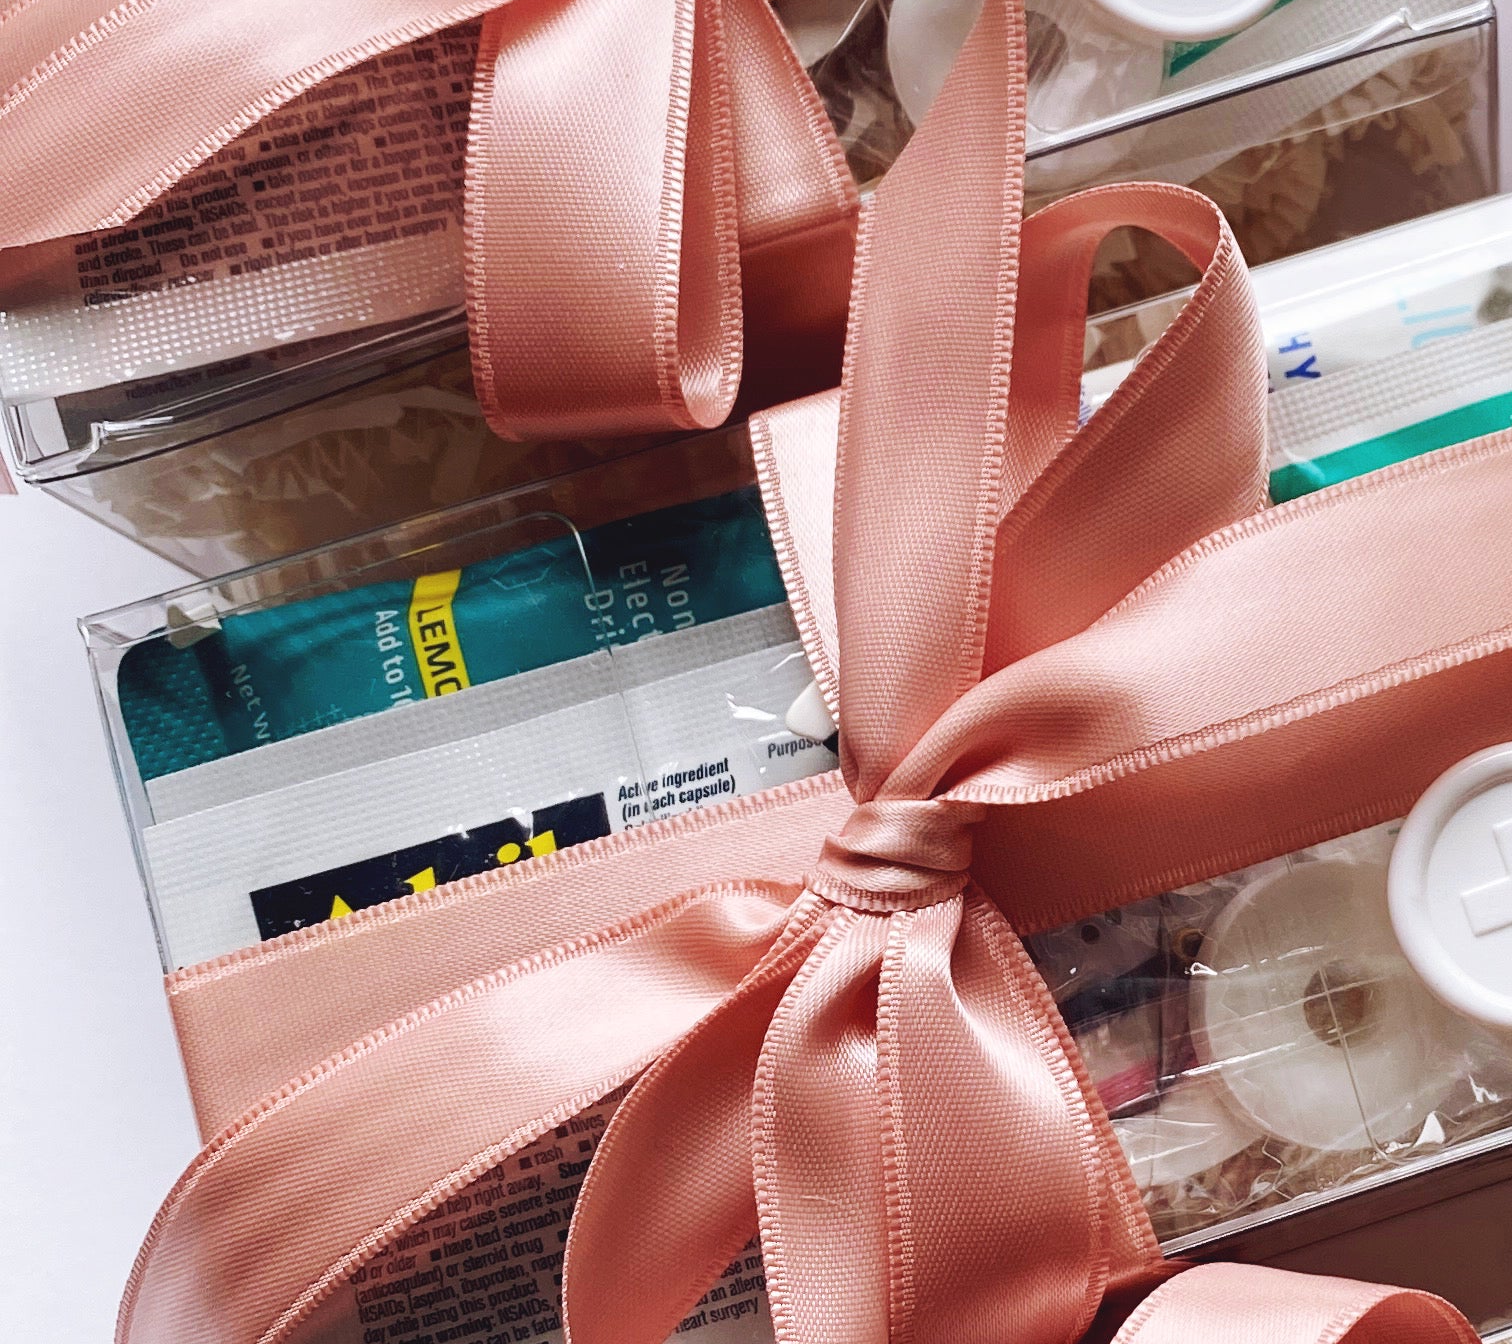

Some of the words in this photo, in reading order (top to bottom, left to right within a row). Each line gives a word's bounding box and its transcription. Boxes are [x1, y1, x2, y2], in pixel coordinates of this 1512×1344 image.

[191, 185, 239, 213] product
[150, 235, 184, 254] These
[620, 560, 663, 641] Elec
[661, 564, 696, 630] Non
[375, 609, 403, 653] Add
[584, 589, 625, 647] Dri
[231, 663, 261, 712] Net
[382, 656, 405, 684] to
[620, 801, 641, 821] (in
[678, 776, 736, 805] capsule)
[662, 759, 730, 798] ingredient
[474, 1183, 504, 1206] right
[508, 1174, 544, 1196] away.
[460, 1211, 495, 1229] cause
[500, 1197, 541, 1217] severe
[475, 1227, 500, 1246] had
[503, 1209, 559, 1237] stomach
[355, 1266, 442, 1305] (anticoagulant)
[463, 1245, 506, 1270] steroid
[510, 1235, 542, 1258] drug
[360, 1298, 404, 1322] NSAIDs
[461, 1262, 527, 1293] ibuprofen,
[422, 1305, 457, 1327] using
[460, 1294, 485, 1313] this
[488, 1280, 538, 1307] product
[710, 1286, 726, 1300] an
[710, 1298, 759, 1324] surgery
[437, 1314, 495, 1344] warning:
[499, 1295, 553, 1325] NSAIDs,
[512, 1323, 529, 1339] be
